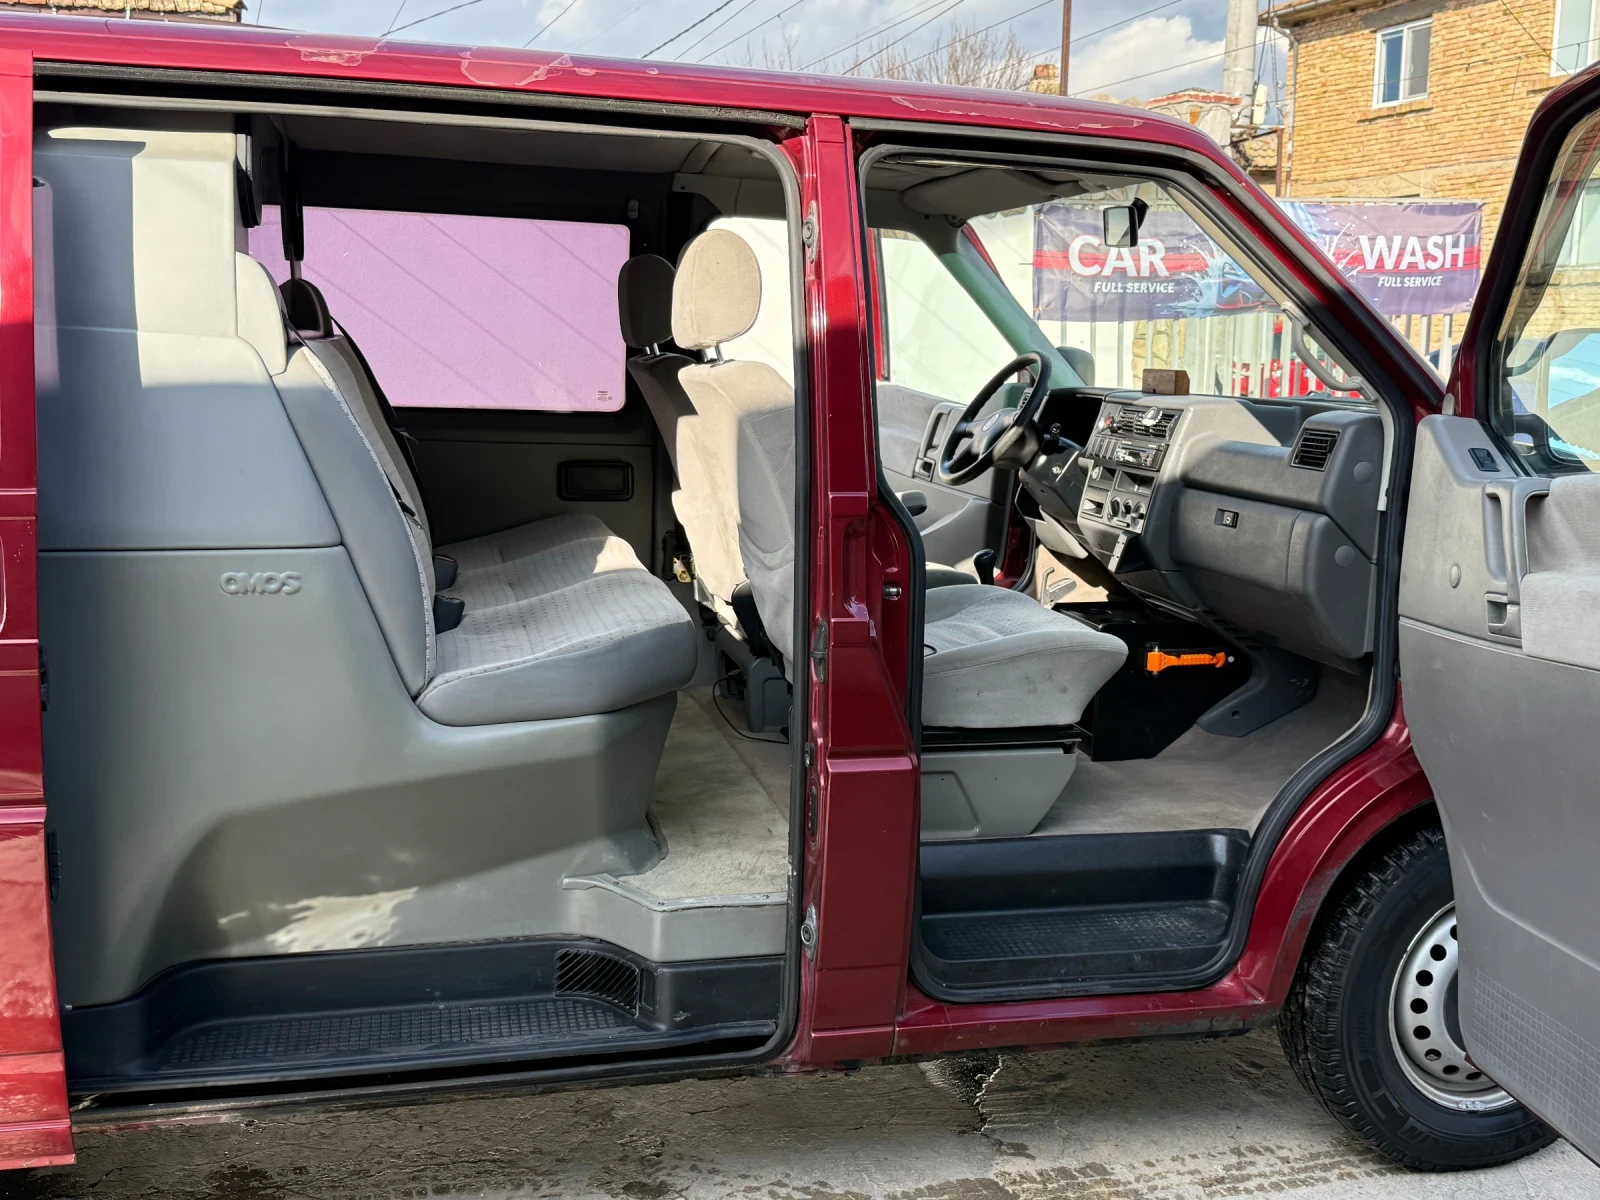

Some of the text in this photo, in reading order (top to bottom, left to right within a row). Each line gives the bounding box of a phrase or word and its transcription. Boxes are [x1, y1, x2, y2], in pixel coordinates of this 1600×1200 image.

[1068, 234, 1466, 278] CAR WASH
[1093, 281, 1175, 293] FULL SERVICE
[1378, 275, 1442, 287] FULL SERVICE
